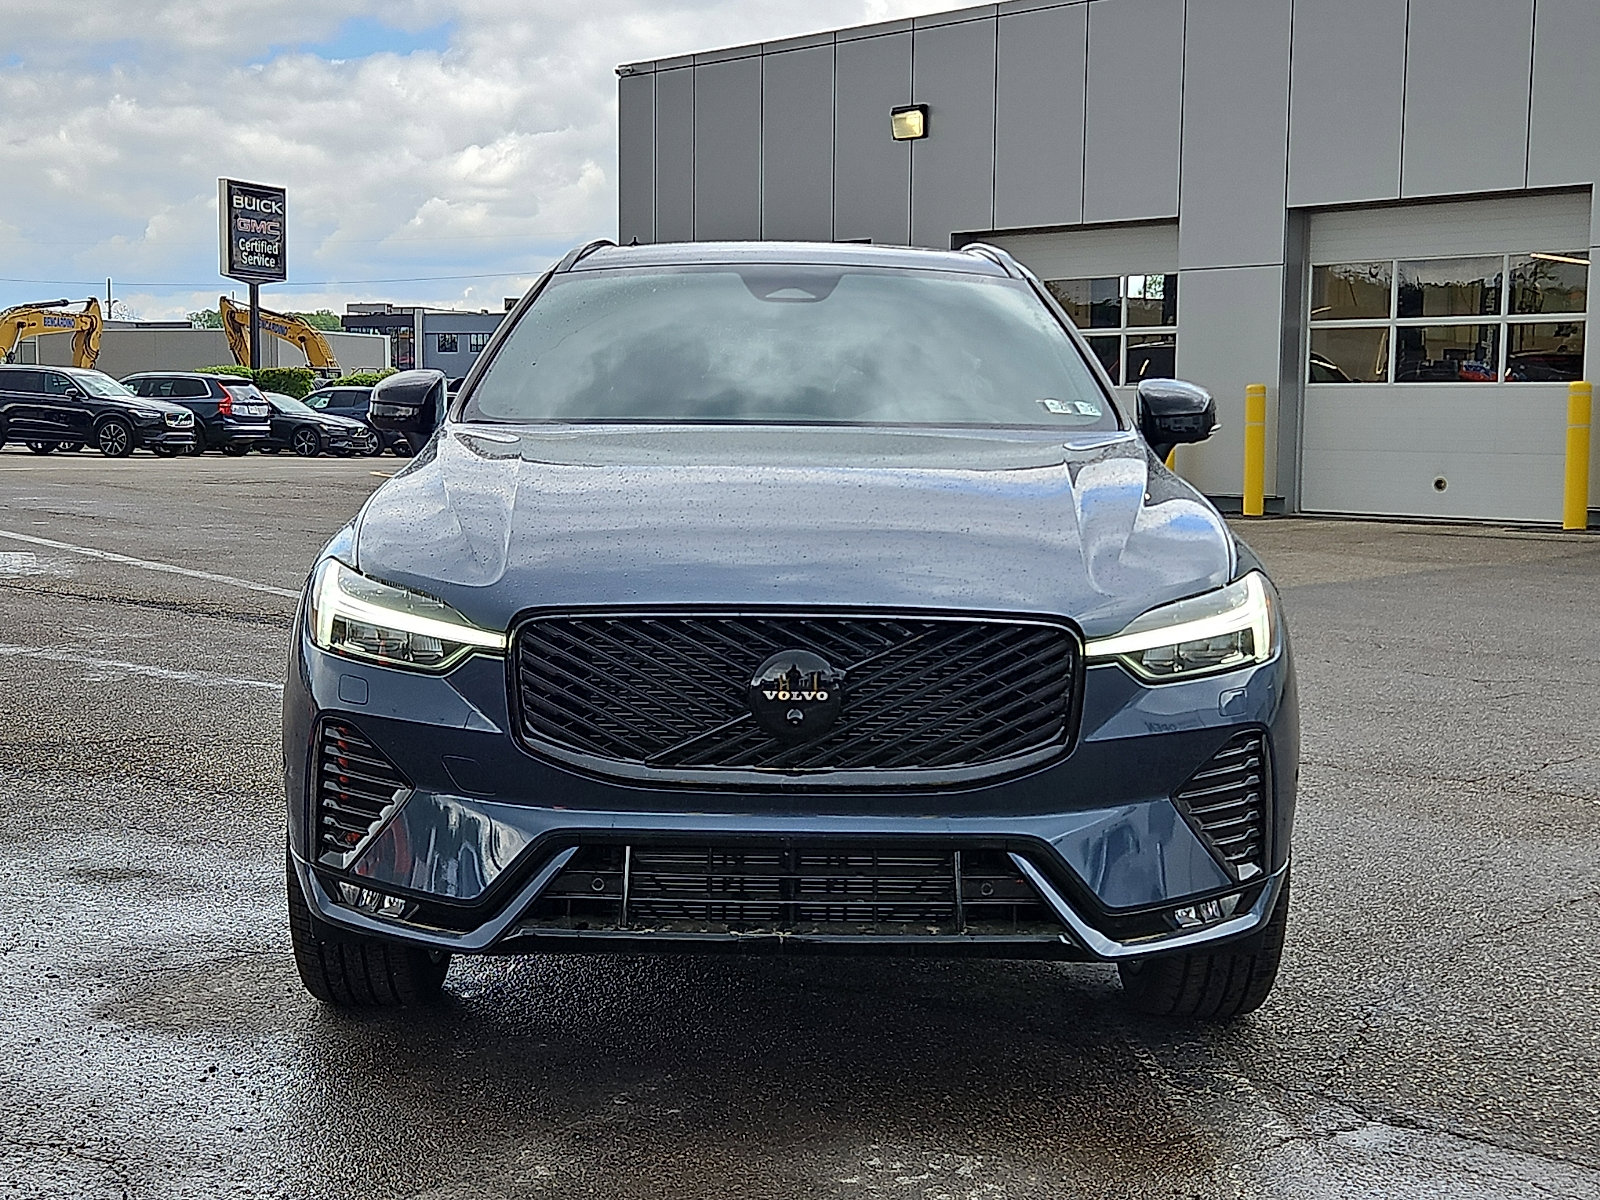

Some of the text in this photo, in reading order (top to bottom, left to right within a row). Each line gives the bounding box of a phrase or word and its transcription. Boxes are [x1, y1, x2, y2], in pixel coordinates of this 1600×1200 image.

[232, 195, 283, 214] BUICK
[236, 217, 281, 236] GMC
[238, 237, 279, 255] Certified
[241, 251, 276, 267] Service
[763, 690, 829, 701] VOLVO
